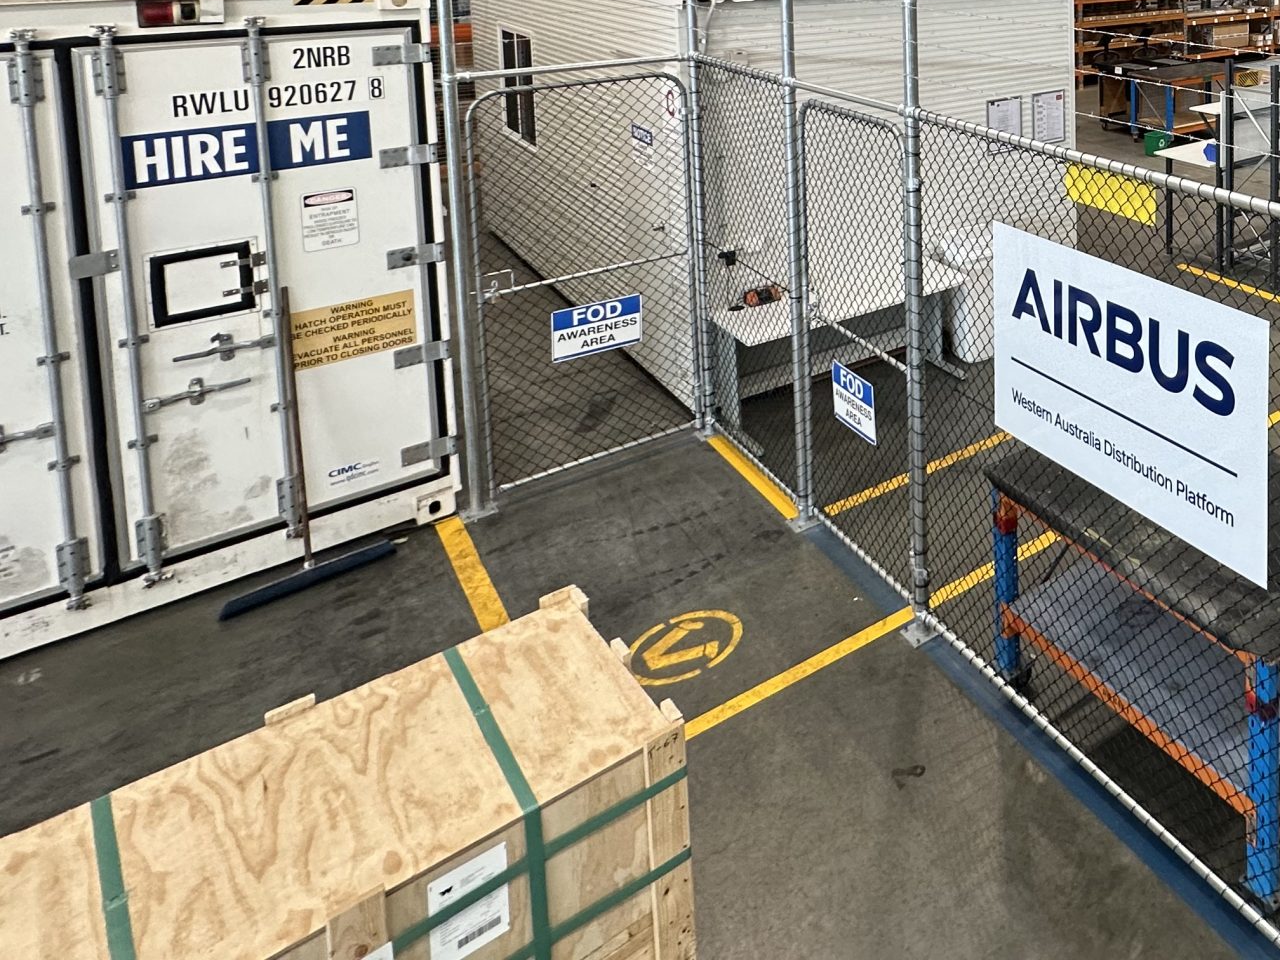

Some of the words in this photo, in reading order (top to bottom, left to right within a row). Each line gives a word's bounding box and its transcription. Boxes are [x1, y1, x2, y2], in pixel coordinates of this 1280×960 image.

[293, 45, 350, 69] 2NRB
[172, 89, 249, 117] RWLU
[269, 80, 357, 108] 920627
[371, 78, 382, 98] 8
[132, 129, 249, 185] HIRE
[289, 117, 351, 163] ME
[295, 318, 326, 331] HATCH
[329, 307, 381, 324] OPERATION
[383, 300, 407, 312] MUST
[330, 300, 374, 314] WARNING
[572, 301, 622, 326] FOD
[305, 323, 349, 338] CHECKED
[351, 308, 413, 328] PERIODICALLY
[333, 328, 376, 343] WARNING
[557, 317, 638, 342] AWARENESS
[293, 345, 340, 361] EVACUATE
[342, 339, 360, 350] ALL
[362, 328, 414, 345] PERSONNEL
[294, 357, 324, 369] PRIOR
[326, 353, 338, 362] TO
[340, 343, 380, 359] CLOSING
[382, 336, 413, 349] DOORS
[581, 334, 616, 349] AREA
[1011, 268, 1236, 417] AIRBUS
[840, 368, 864, 399] FOD
[835, 388, 872, 421] AWARENESS
[846, 409, 862, 427] AREA
[328, 462, 362, 478] CIMC
[1011, 387, 1052, 424] Western
[1054, 412, 1101, 452] Australia
[1104, 440, 1173, 493] Distribution
[1176, 480, 1234, 528] Platform
